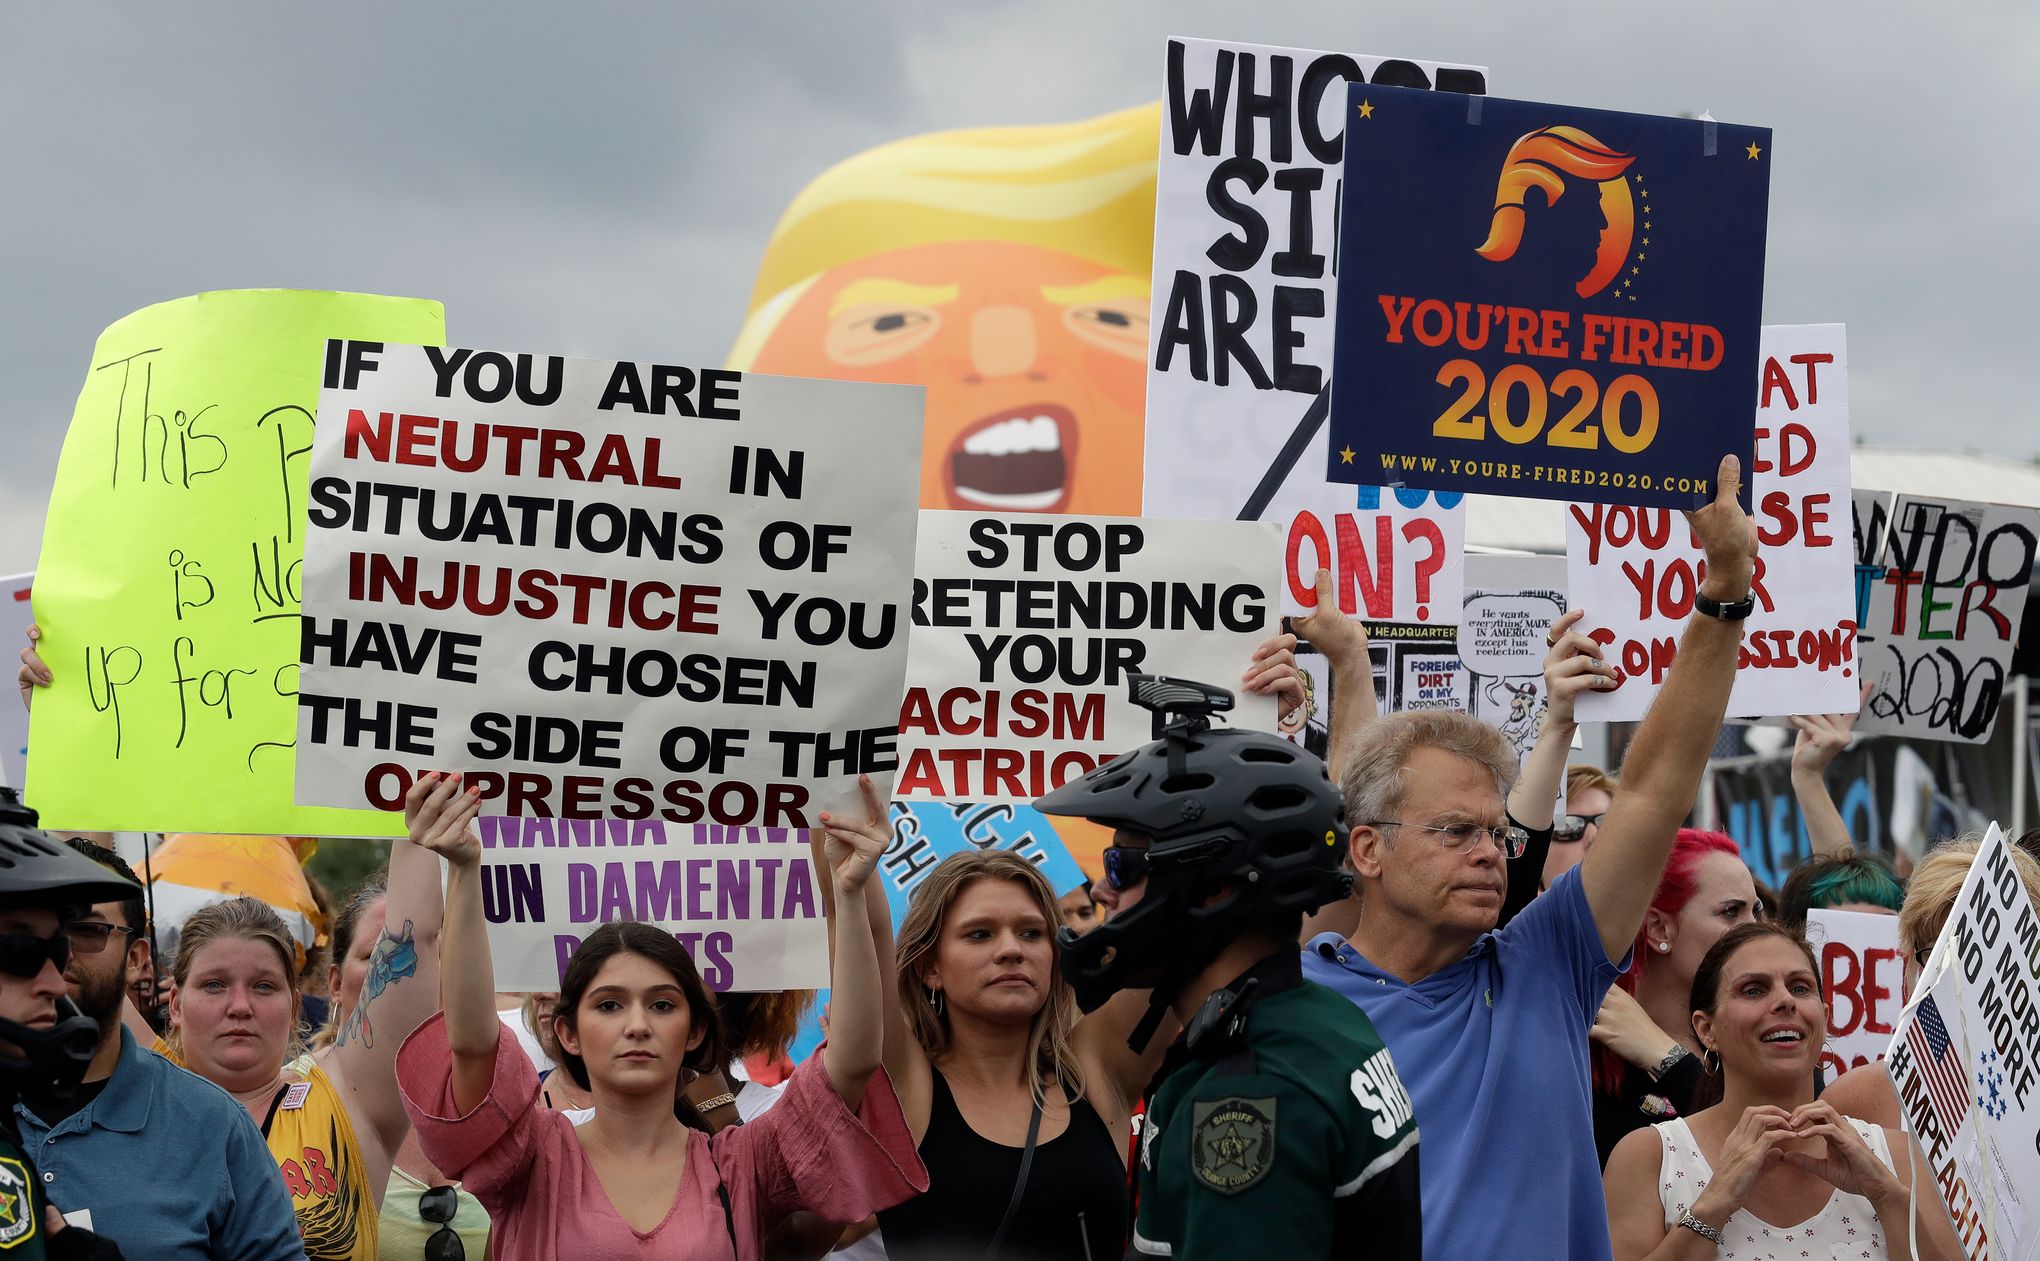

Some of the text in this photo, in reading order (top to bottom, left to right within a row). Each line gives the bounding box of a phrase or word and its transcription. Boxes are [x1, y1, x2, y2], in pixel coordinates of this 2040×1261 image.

[1168, 40, 1486, 164] WHO
[1206, 157, 1342, 278] SI
[1155, 270, 1325, 394] ARE
[1378, 295, 1724, 371] YOU'RE FIRED
[324, 339, 742, 421] IF YOU ARE
[1433, 359, 1660, 454] 2020
[1760, 353, 1834, 412] AT
[96, 347, 228, 490] This
[1753, 423, 1817, 477] ID
[343, 409, 805, 500] NEUTRAL IN
[1381, 453, 1708, 494] WWW.YOURE-FIRED2020.COM
[308, 476, 852, 573] SITUATIONS OF
[967, 519, 1144, 572] STOP
[1569, 502, 1671, 566] YOU
[1852, 499, 2038, 590] NDO
[169, 549, 214, 620] is
[1285, 509, 1446, 622] ON?
[1621, 557, 1775, 621] YOR
[349, 552, 897, 650] INJUSTICE YOU
[911, 578, 1266, 633] RETENDING
[1375, 626, 1457, 638] HEADQUARTER
[1468, 619, 1551, 630] everything MADE
[1476, 628, 1538, 638] IN AMERICA,
[1481, 608, 1530, 619] He wants
[1854, 565, 2012, 641] TTER
[300, 616, 816, 709] HAVE CHOSEN
[964, 633, 1147, 686] YOUR
[1410, 660, 1462, 672] FOREIGN
[1475, 638, 1529, 648] except his
[86, 645, 142, 759] up
[170, 636, 258, 748] for
[898, 687, 1106, 741] ACISM
[1407, 697, 1460, 710] OPPONENTS
[1417, 673, 1455, 688] DIRT
[1418, 687, 1454, 699] ON MY
[1870, 644, 2004, 740] 2020
[298, 693, 438, 757] THE
[466, 711, 624, 770] SIDE
[659, 725, 750, 775] OF
[769, 725, 899, 778] THE
[364, 762, 810, 829] OPRESSOR
[895, 748, 1120, 798] ATRIO
[481, 858, 828, 924] UN DAMENTA
[1969, 876, 2001, 950] NO
[1986, 840, 2040, 996] NO MO
[1822, 942, 1908, 1038] BE
[1955, 912, 1983, 985] NO
[1978, 976, 2036, 1111] MORE
[1212, 1111, 1255, 1125] SHERIFF
[1229, 1163, 1260, 1186] COUNTY
